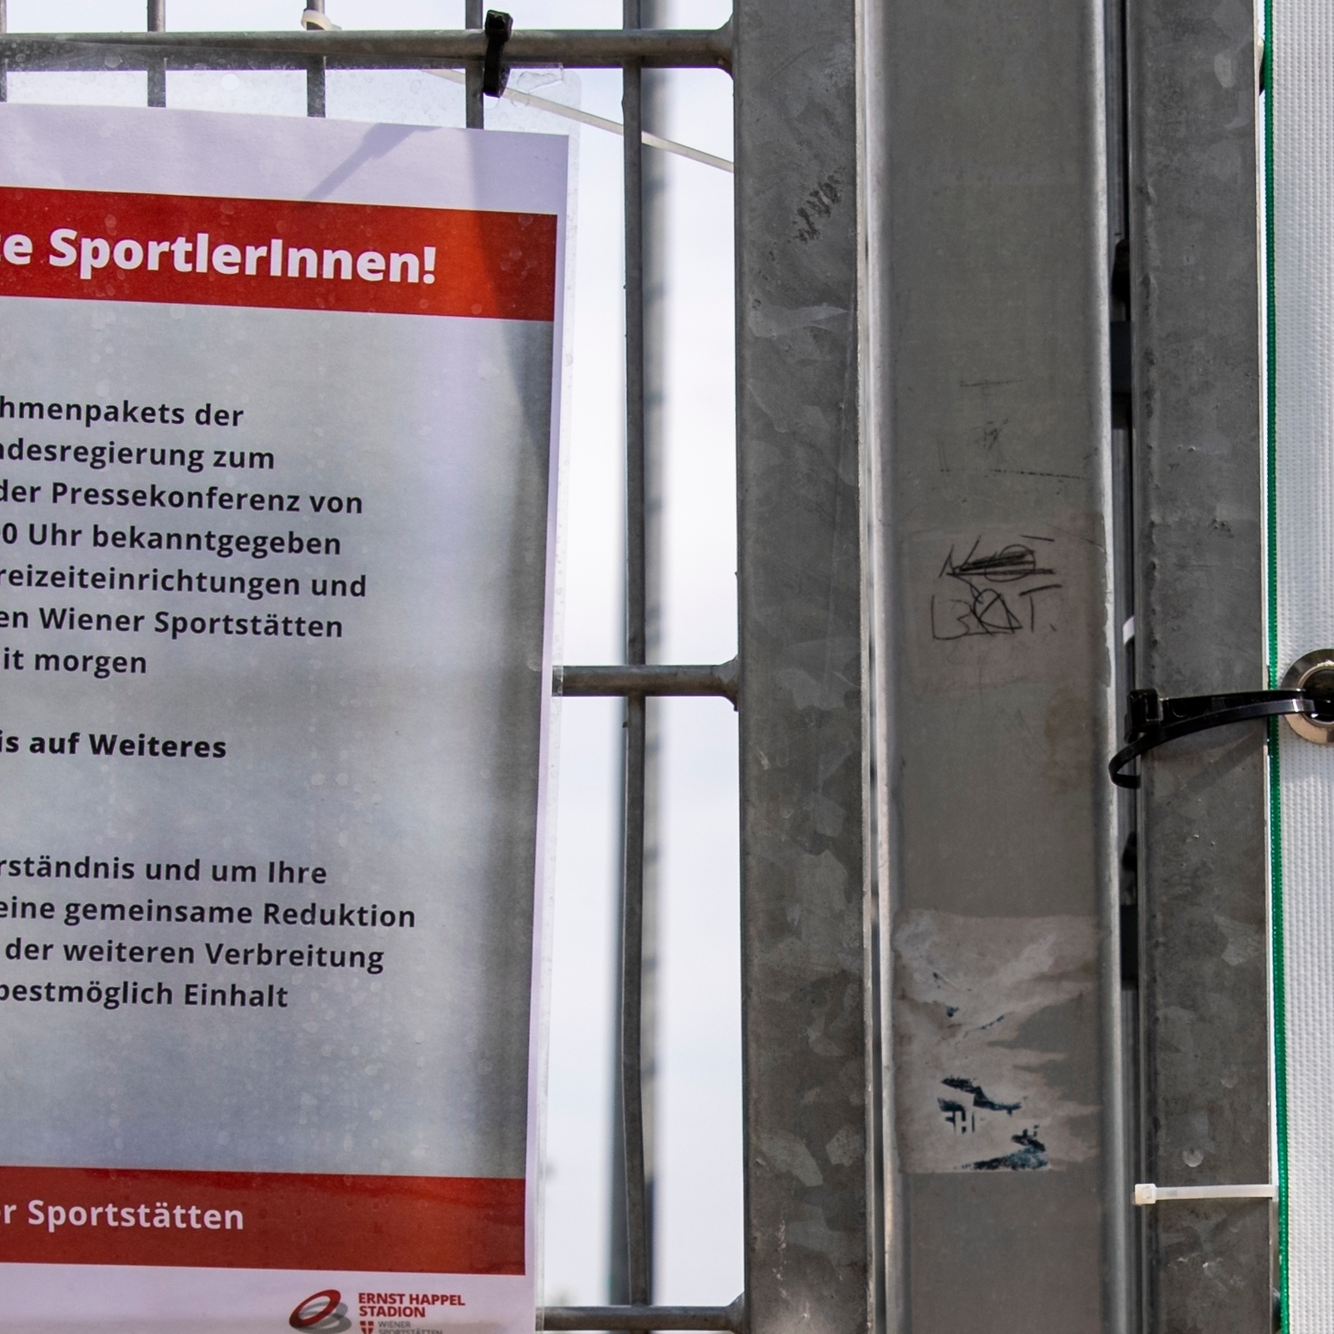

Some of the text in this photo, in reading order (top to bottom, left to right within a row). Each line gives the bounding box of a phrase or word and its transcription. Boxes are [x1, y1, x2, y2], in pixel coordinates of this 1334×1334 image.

[47, 228, 437, 285] SportlerInnen!
[193, 401, 246, 428] der
[211, 449, 276, 471] zum
[51, 480, 302, 514] Pressekonferenz
[307, 494, 364, 516] von
[27, 521, 84, 548] Uhr
[91, 522, 342, 561] bekanntgegeben
[310, 573, 368, 599] und
[37, 605, 147, 633] Wiener
[153, 609, 344, 641] Sportstätten
[33, 652, 148, 681] morgen
[27, 730, 82, 756] auf
[87, 732, 228, 760] Weiteres
[144, 857, 202, 883] und
[210, 863, 258, 884] um
[267, 859, 329, 886] Ihre
[62, 897, 254, 928] gemeinsame
[262, 901, 417, 929] Reduktion
[3, 935, 56, 962] der
[61, 938, 196, 965] weiteren
[203, 941, 386, 976] Verbreitung
[183, 981, 290, 1009] Einhalt
[26, 1198, 245, 1235] Sportstätten
[358, 1292, 465, 1306] ERNST HAPPEL
[359, 1306, 426, 1318] STADION
[378, 1320, 412, 1329] WIENER
